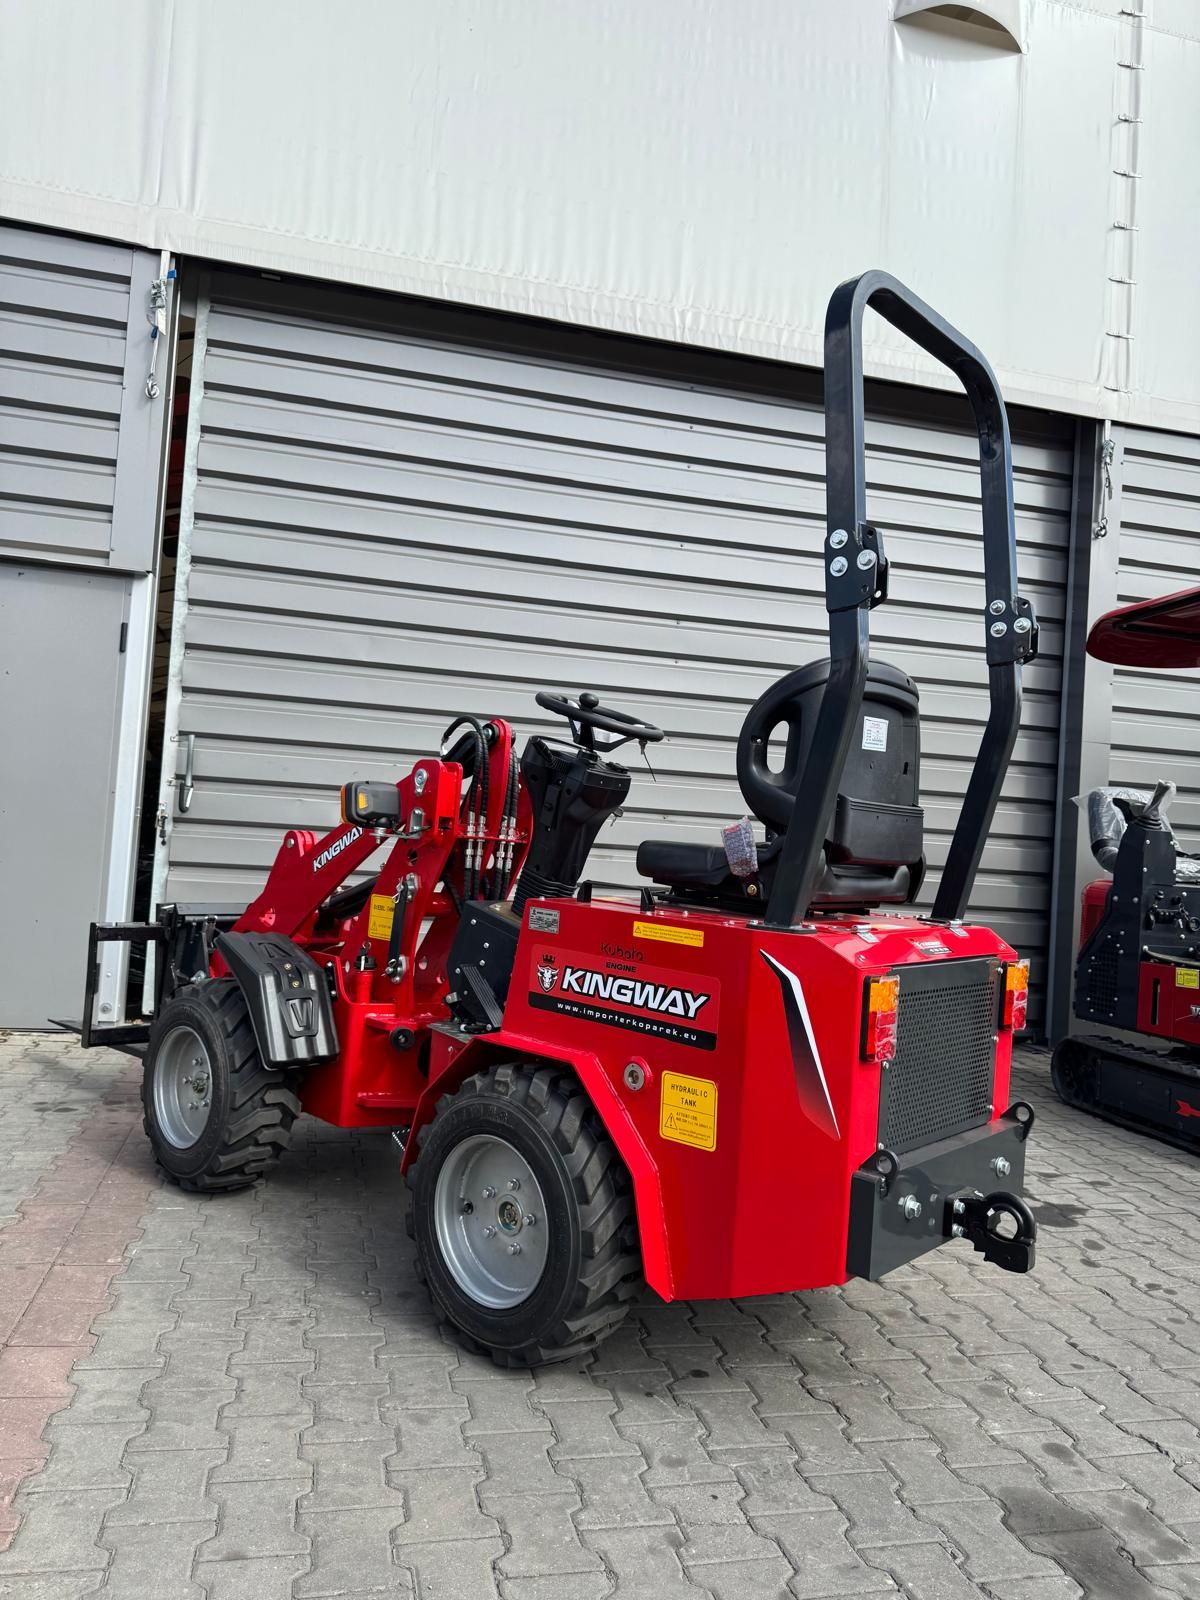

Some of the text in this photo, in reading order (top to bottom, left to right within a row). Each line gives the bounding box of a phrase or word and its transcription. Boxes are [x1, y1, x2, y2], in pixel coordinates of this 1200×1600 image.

[313, 826, 364, 873] KINGWAY
[601, 943, 644, 961] Kubota
[606, 962, 637, 973] ENGINE
[561, 966, 709, 1020] KINGWAY
[557, 1002, 698, 1041] www.importerkoparek.eu
[670, 1083, 708, 1098] HYDRAULIC
[681, 1097, 697, 1108] TANK
